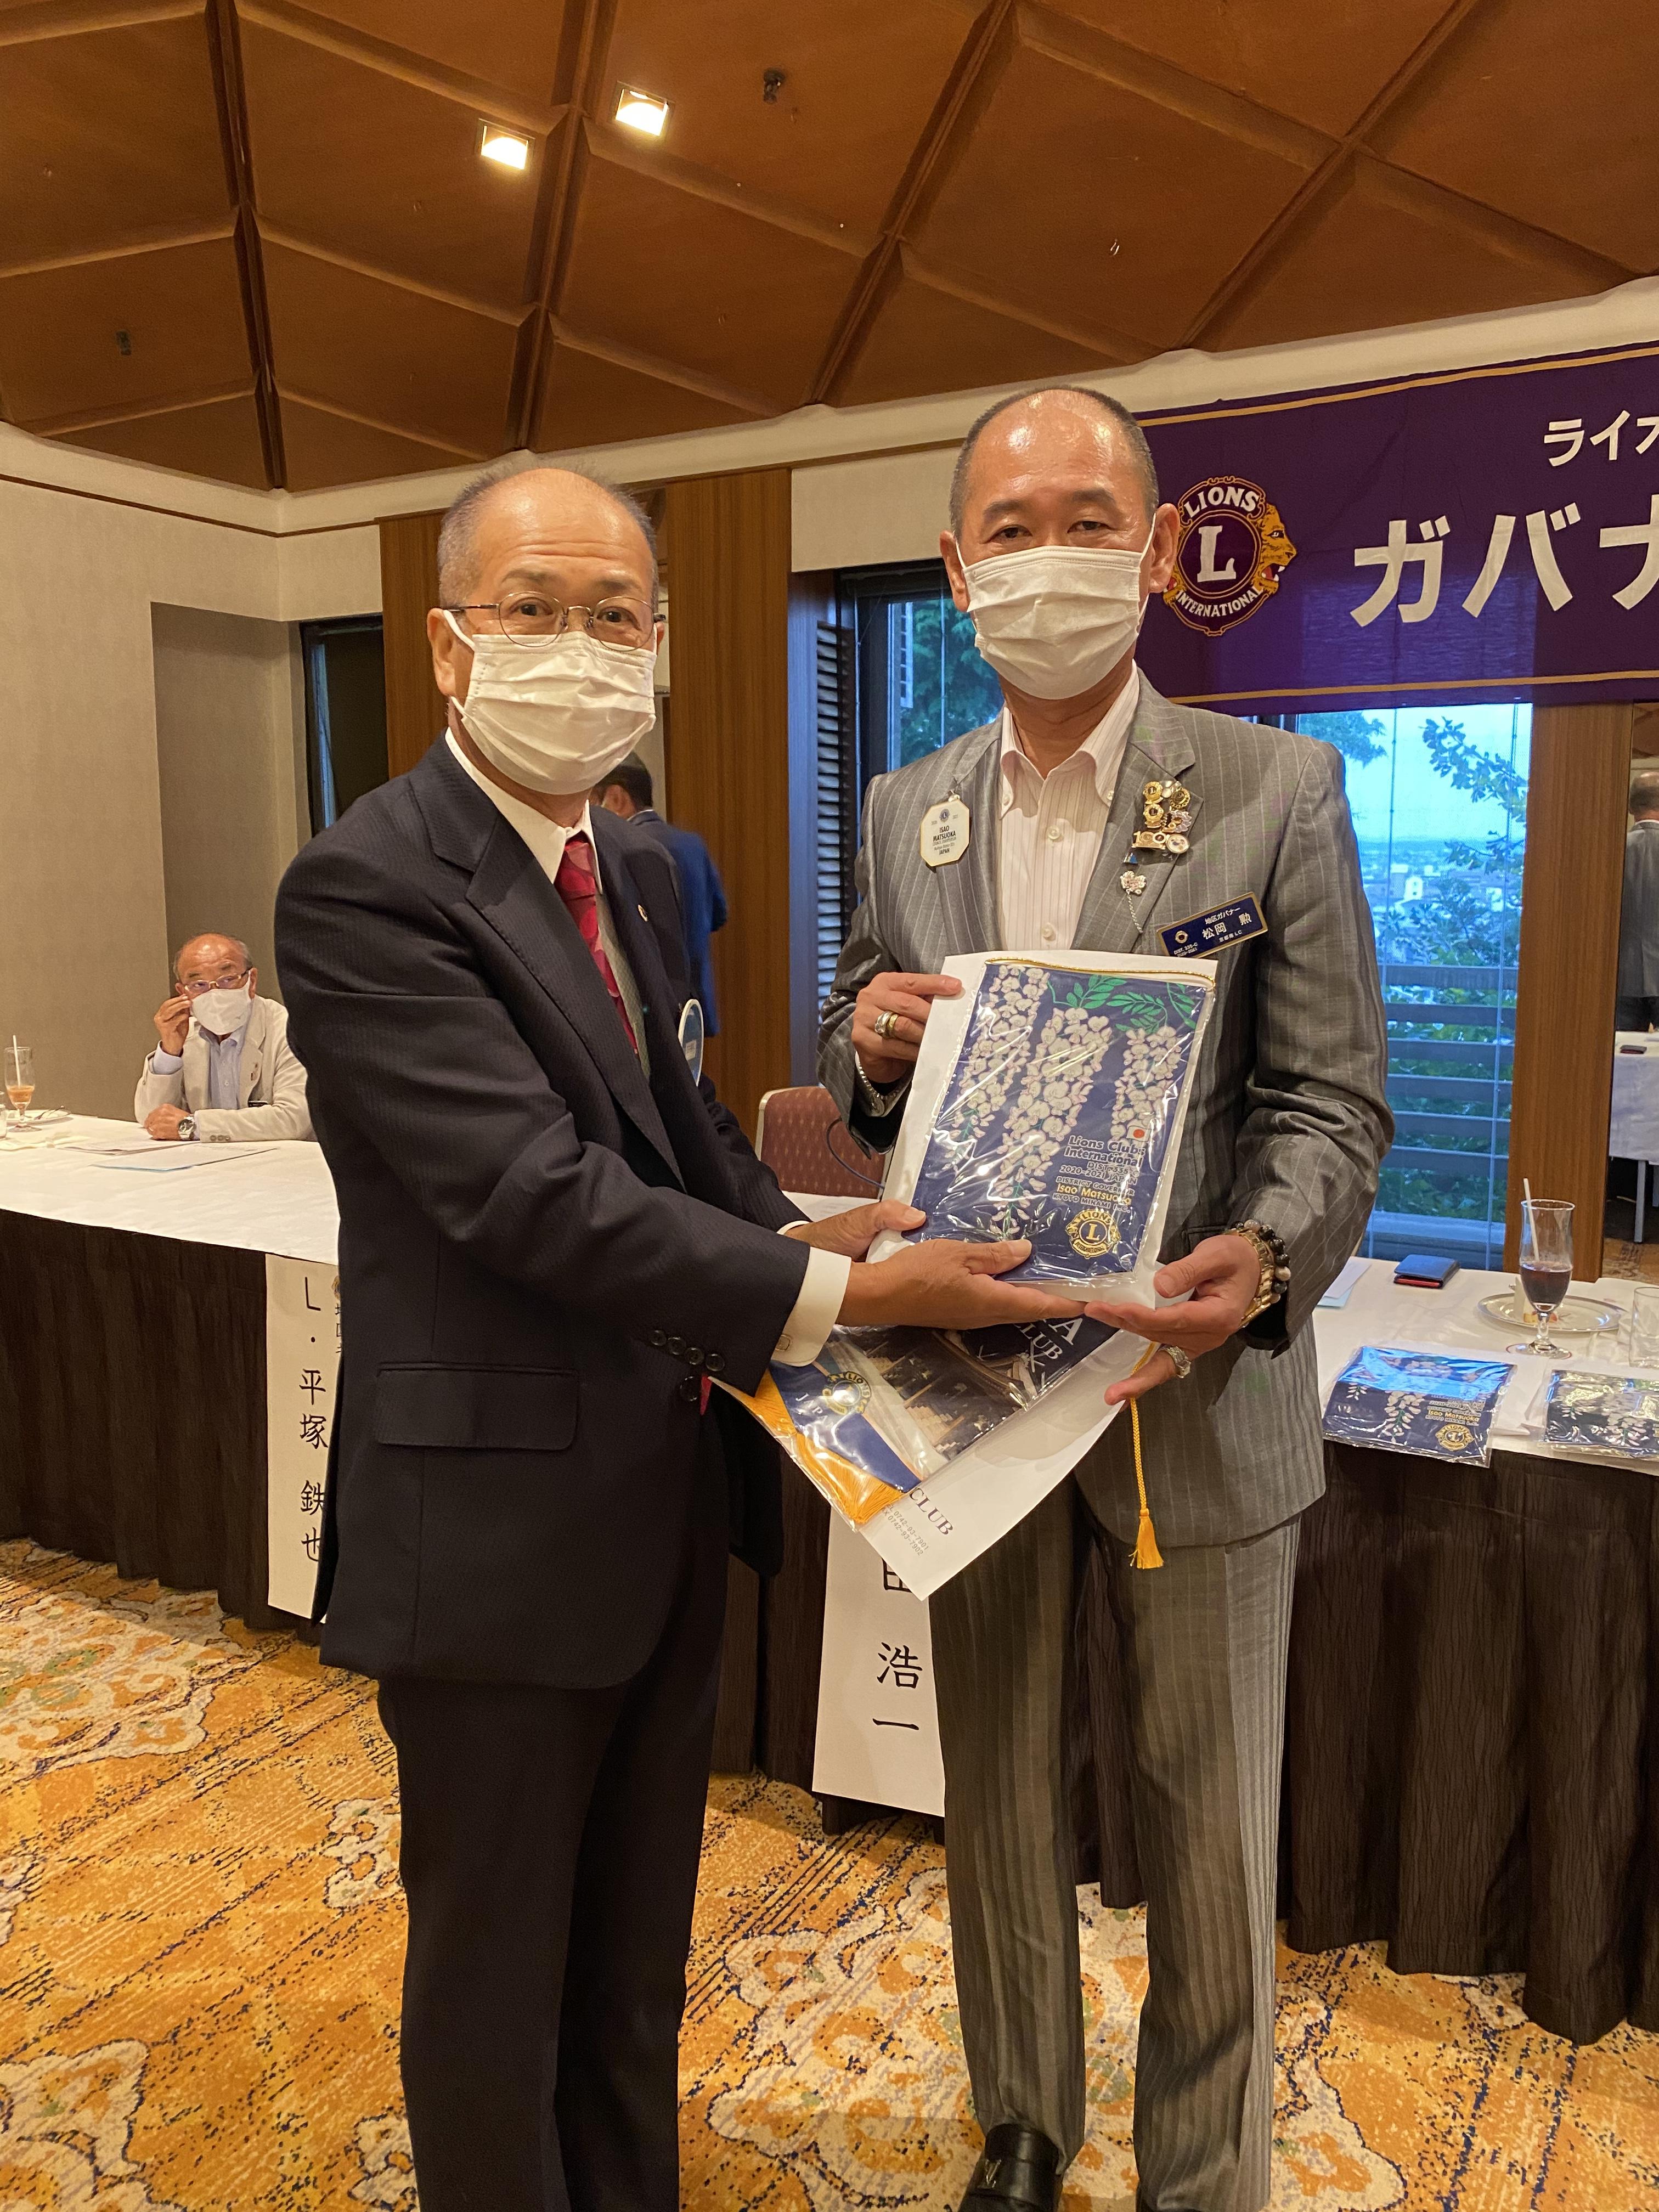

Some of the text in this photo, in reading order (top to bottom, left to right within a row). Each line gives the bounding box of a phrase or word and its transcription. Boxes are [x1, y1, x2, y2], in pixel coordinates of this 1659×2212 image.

[1184, 486, 1259, 518] LIONS
[1197, 526, 1237, 582] L
[1175, 586, 1264, 617] INTERNATIONAL
[933, 831, 956, 842] MATSUOKA
[1202, 922, 1227, 940] 松岡
[1068, 1135, 1146, 1156] Lions Clubs
[1064, 1146, 1143, 1168] International
[1056, 1176, 1092, 1188] DISTRICT
[1059, 1165, 1138, 1185] 2020-2021 JAPN
[1057, 1183, 1078, 1195] Isao
[1052, 1193, 1080, 1203] KYOTO
[1081, 1197, 1111, 1208] MINAMI
[1086, 1223, 1101, 1240] L
[1014, 1323, 1063, 1359] LUB
[1444, 1412, 1480, 1422] Matsuoka
[909, 1488, 953, 1535] CLUB
[888, 1515, 924, 1556] 0742-93-7902
[894, 1511, 929, 1550] 0742-93-7901
